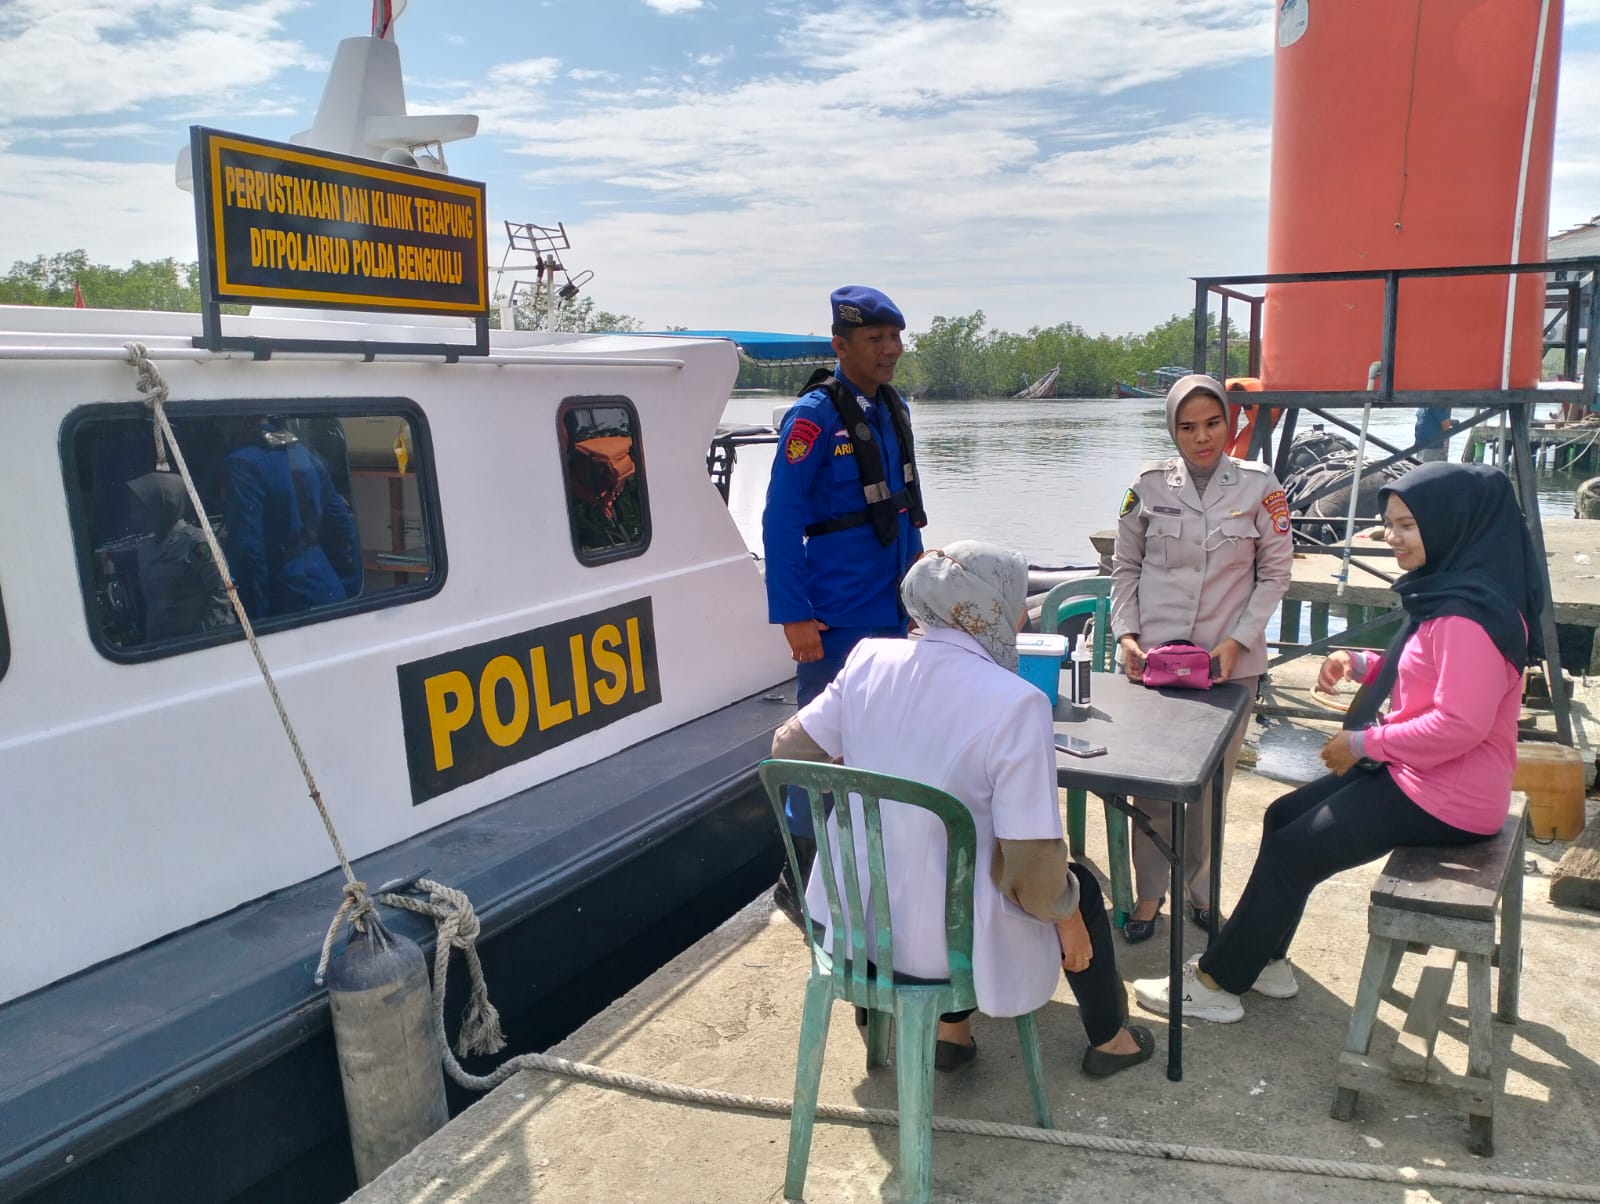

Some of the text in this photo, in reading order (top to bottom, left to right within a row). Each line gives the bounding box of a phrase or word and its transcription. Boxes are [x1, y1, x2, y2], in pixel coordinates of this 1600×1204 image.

[225, 166, 473, 239] PERPUSTAKAAN DAN KLINIK TERAPUNG
[250, 227, 463, 285] DITPOLAIRUD POLDA BENGKULU
[425, 616, 646, 772] POLISI
